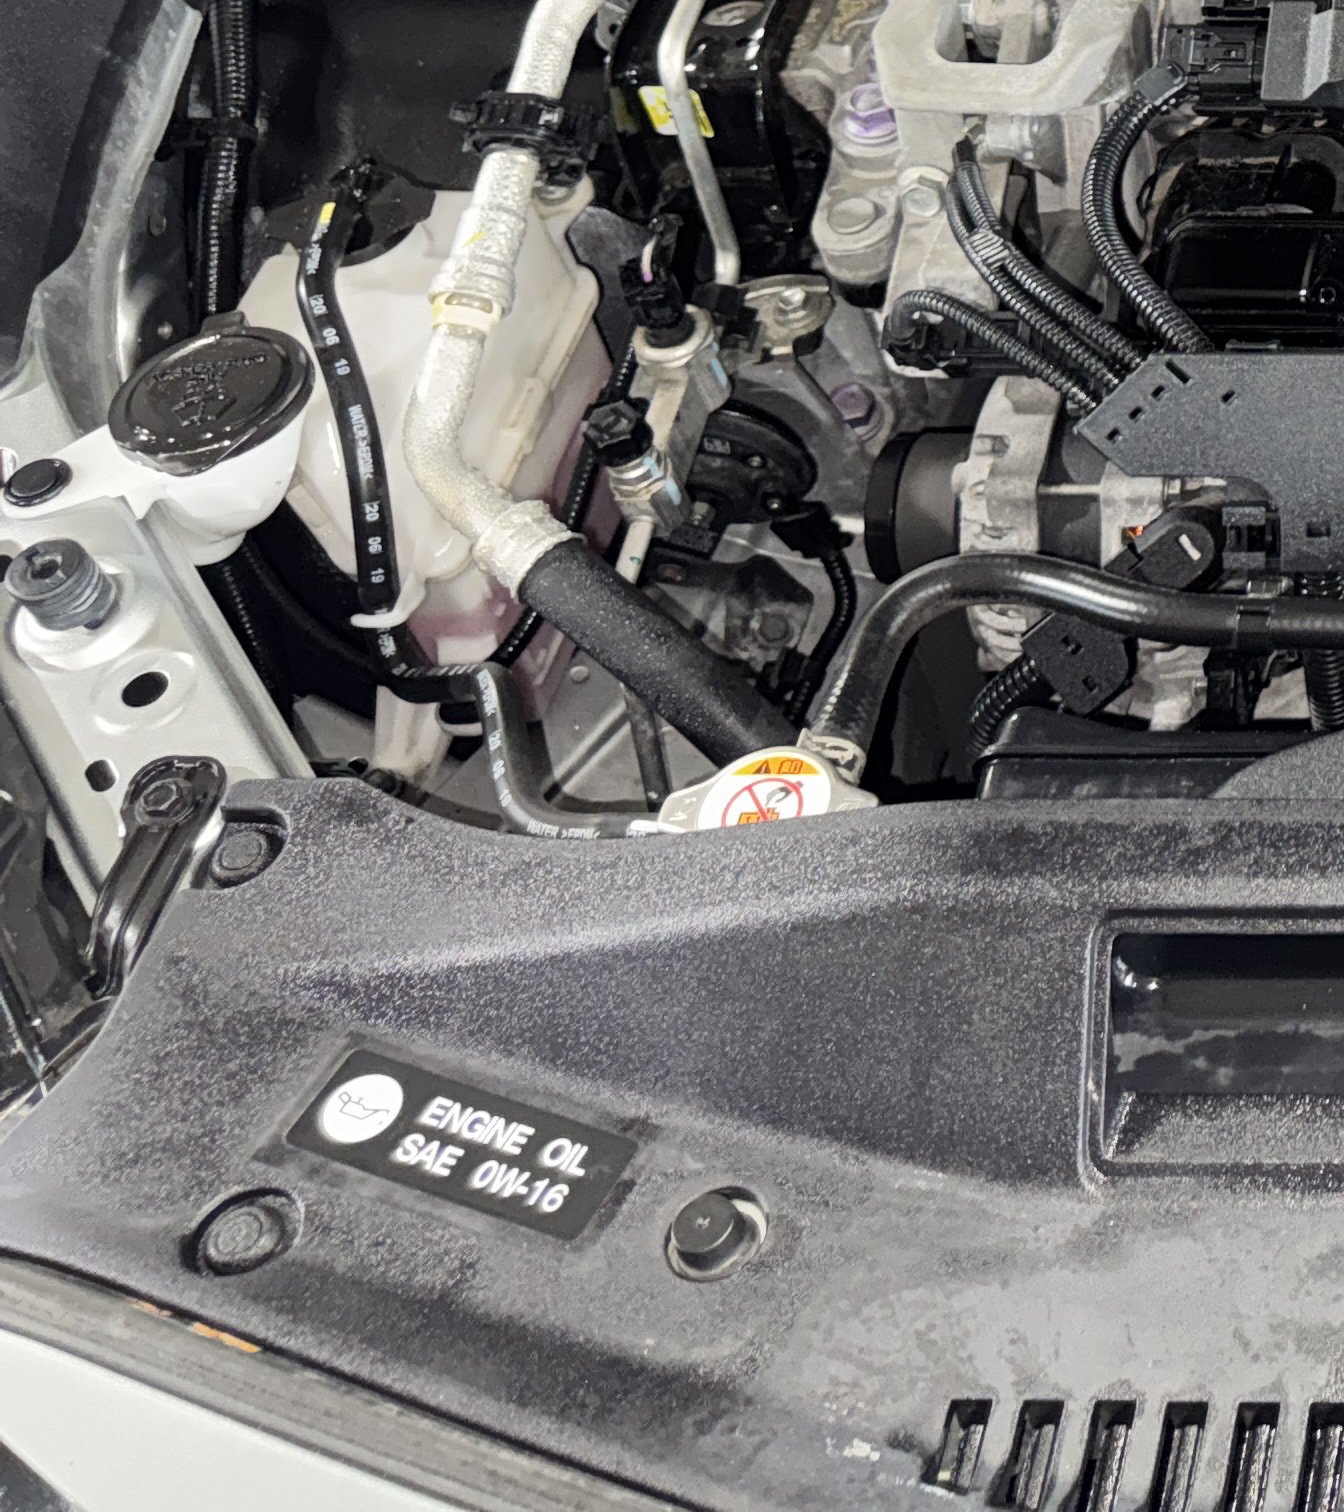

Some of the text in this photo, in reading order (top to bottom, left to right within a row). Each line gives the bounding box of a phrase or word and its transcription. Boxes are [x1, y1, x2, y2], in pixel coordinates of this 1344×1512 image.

[348, 404, 367, 439] WATER
[526, 819, 560, 837] WATER
[418, 1095, 590, 1178] ENGINE OIL
[392, 1133, 571, 1213] SAE 0W-16
